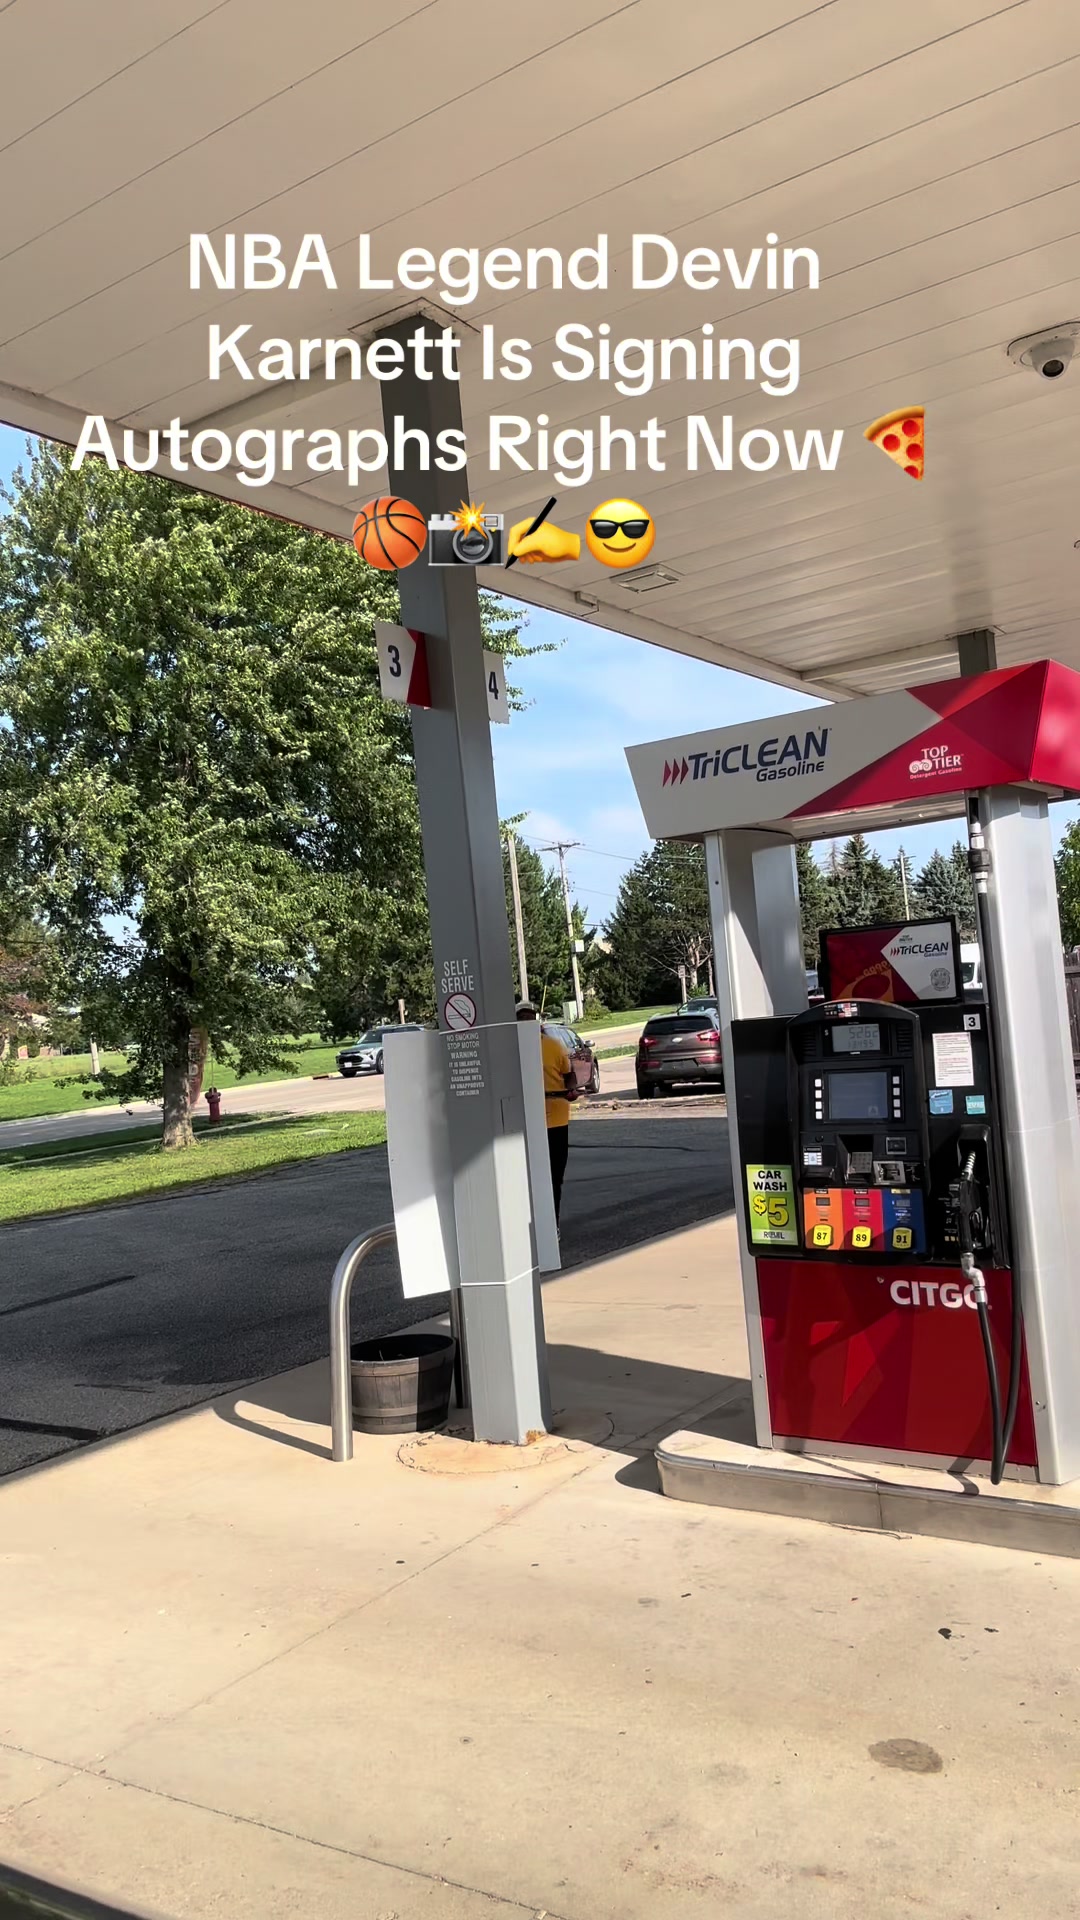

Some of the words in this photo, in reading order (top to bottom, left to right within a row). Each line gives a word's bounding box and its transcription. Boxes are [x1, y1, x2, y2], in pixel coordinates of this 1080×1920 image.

[387, 644, 402, 678] 3
[488, 671, 499, 700] 4
[688, 728, 829, 780] TriCLEAN
[921, 745, 949, 759] TOP
[932, 755, 962, 769] TIER
[756, 761, 825, 782] Gasoline
[900, 942, 949, 955] TriCLEAN
[443, 959, 468, 977] SELF
[441, 975, 475, 994] SERVE
[968, 1017, 976, 1027] 3
[446, 1034, 455, 1042] NO
[455, 1032, 479, 1041] SMOKING
[447, 1042, 461, 1050] STOP
[461, 1041, 480, 1049] MOTOR
[450, 1050, 478, 1059] WARNING
[758, 1170, 782, 1179] CAR
[753, 1181, 788, 1191] WASH
[753, 1194, 789, 1227] $5
[816, 1232, 828, 1240] 87
[855, 1234, 867, 1242] 89
[896, 1235, 907, 1243] 91
[889, 1280, 988, 1310] CITGO
